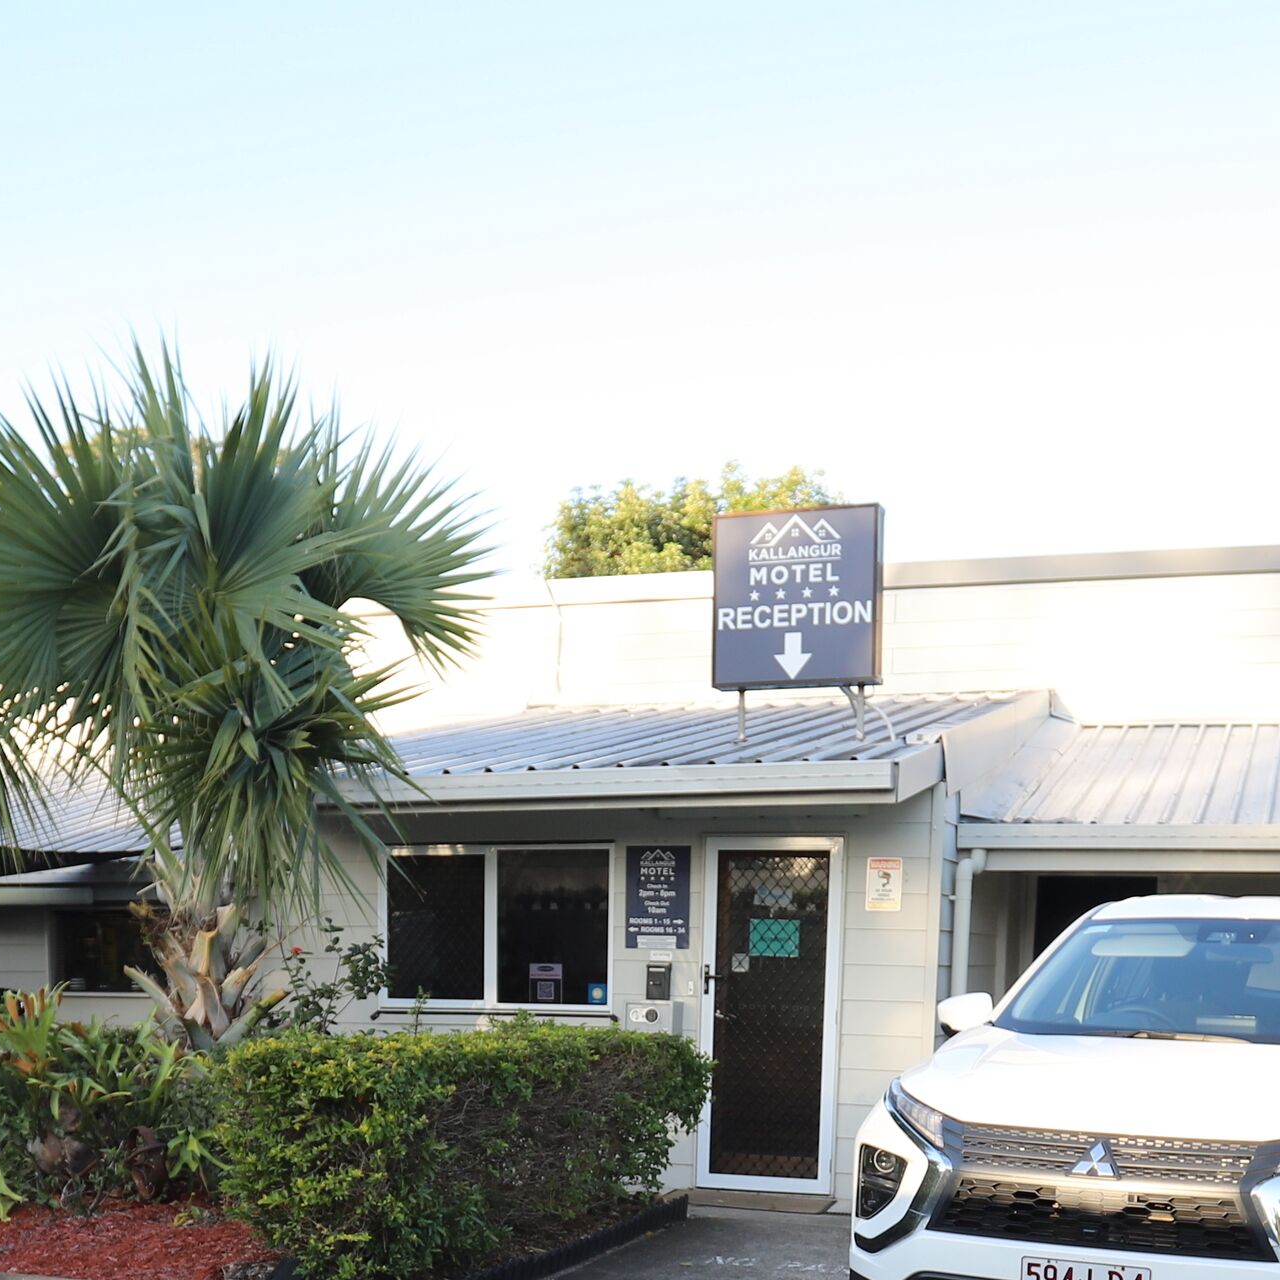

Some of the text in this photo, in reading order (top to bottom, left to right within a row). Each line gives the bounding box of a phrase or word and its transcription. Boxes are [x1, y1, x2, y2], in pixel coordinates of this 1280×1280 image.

[748, 543, 842, 561] KALLANGUR
[749, 563, 840, 586] MOTEL
[717, 600, 873, 630] RECEPTION
[640, 867, 675, 875] MOTEL
[640, 926, 665, 934] ROOMS
